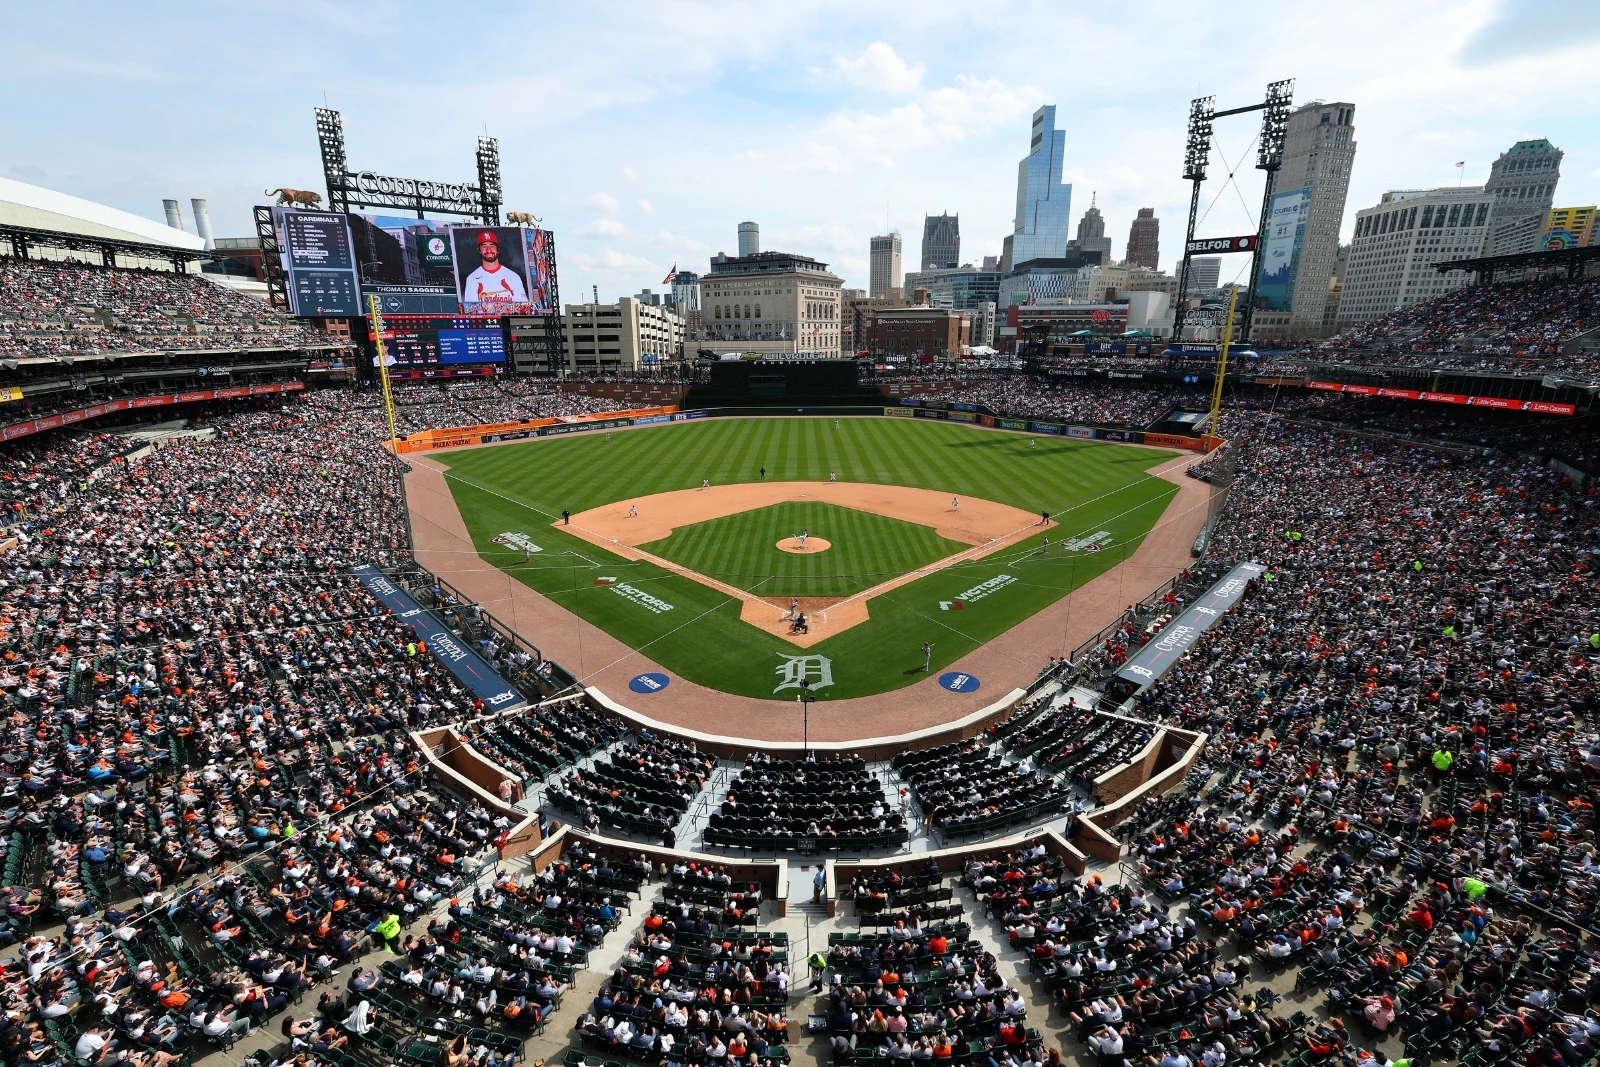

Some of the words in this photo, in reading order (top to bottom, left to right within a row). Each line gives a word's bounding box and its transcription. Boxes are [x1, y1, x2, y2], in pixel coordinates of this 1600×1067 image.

[356, 170, 476, 206] Comerica
[1278, 227, 1287, 235] #1
[1188, 240, 1231, 251] BELFOR
[765, 352, 823, 360] CHEVROLET
[886, 355, 908, 363] meijer
[1549, 405, 1571, 413] Caesars
[1002, 421, 1026, 430] bet365
[1072, 429, 1089, 437] meijer
[433, 440, 451, 448] PIZZA!
[1164, 436, 1183, 444] PIZZA!
[369, 584, 381, 592] PARK
[370, 577, 397, 596] Comerica
[954, 574, 1011, 600] VICTORS
[1214, 579, 1244, 598] Comerica
[1232, 584, 1245, 594] PARK
[615, 582, 674, 611] VICTORS
[1155, 625, 1194, 652] Comerica
[1177, 634, 1194, 647] PARK
[430, 633, 468, 662] Comerica
[433, 643, 447, 656] PARK
[772, 652, 835, 694] D
[487, 690, 515, 705] D
